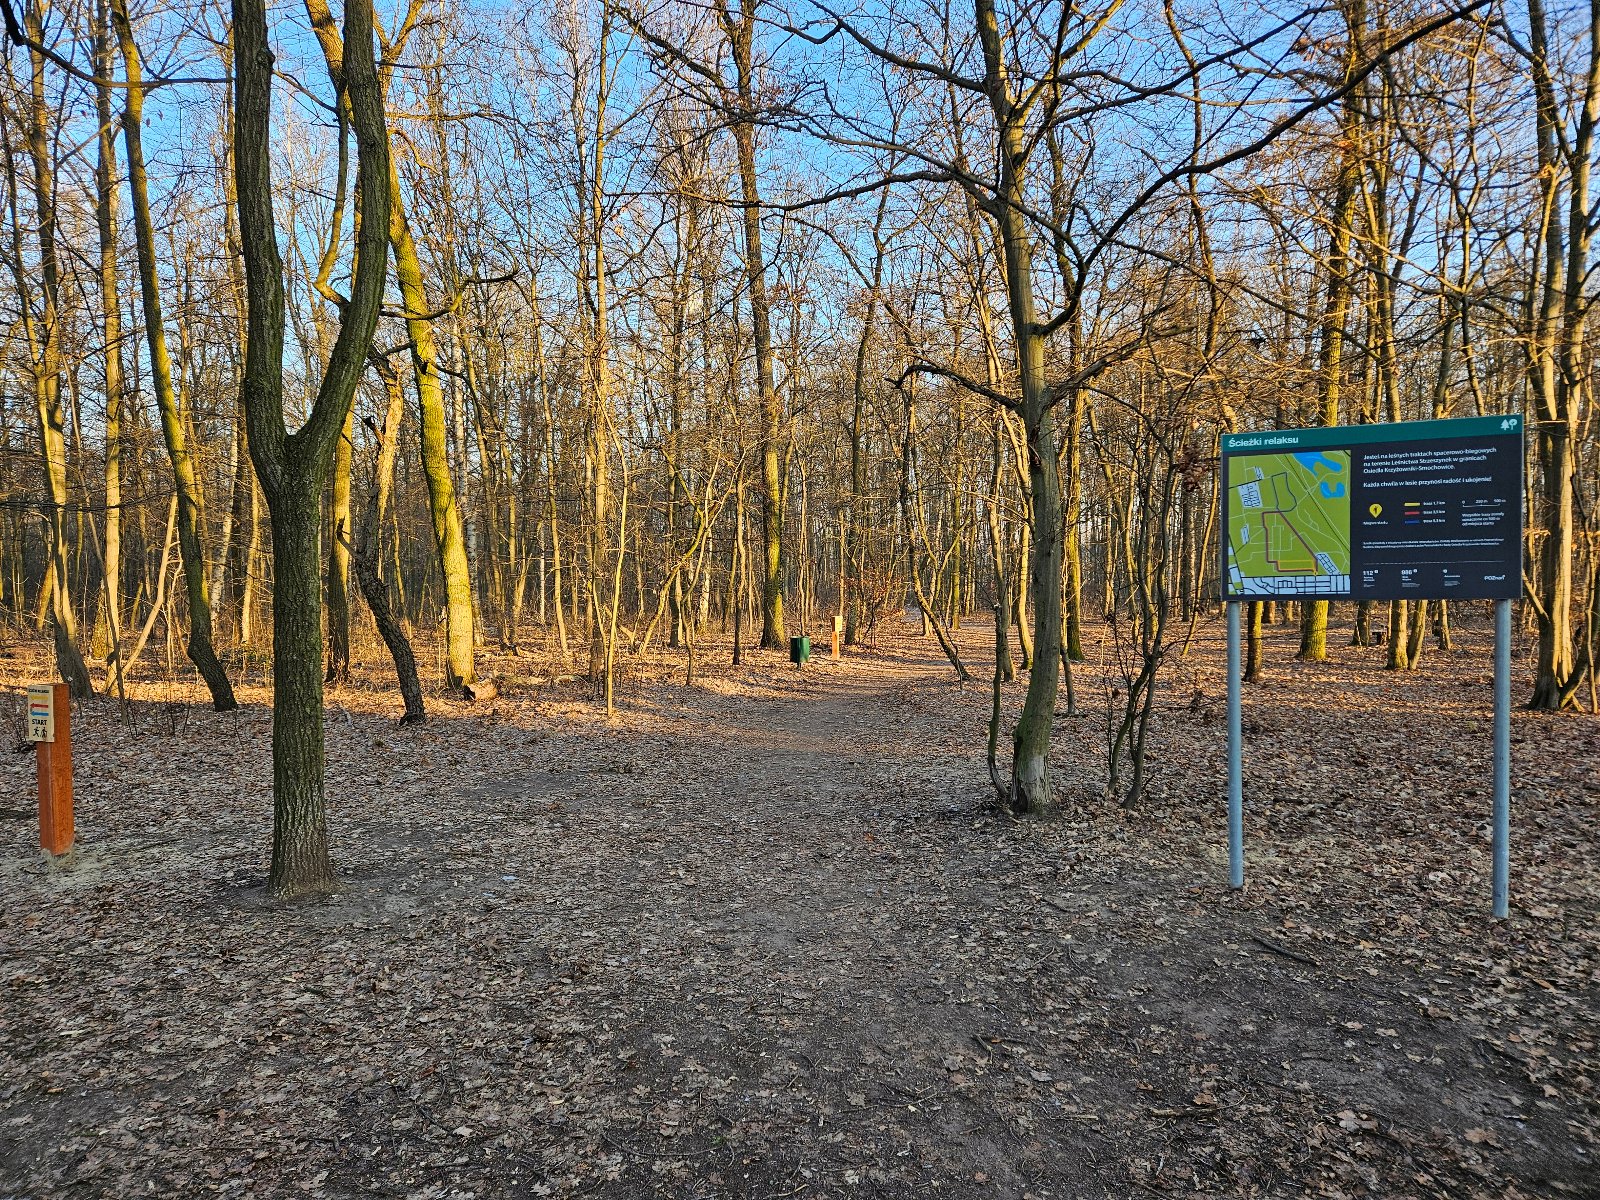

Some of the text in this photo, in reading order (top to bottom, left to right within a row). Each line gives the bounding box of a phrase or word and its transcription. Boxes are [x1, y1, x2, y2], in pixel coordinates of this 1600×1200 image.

[1228, 436, 1299, 447] Ścieżki relaksu
[31, 718, 48, 726] START
